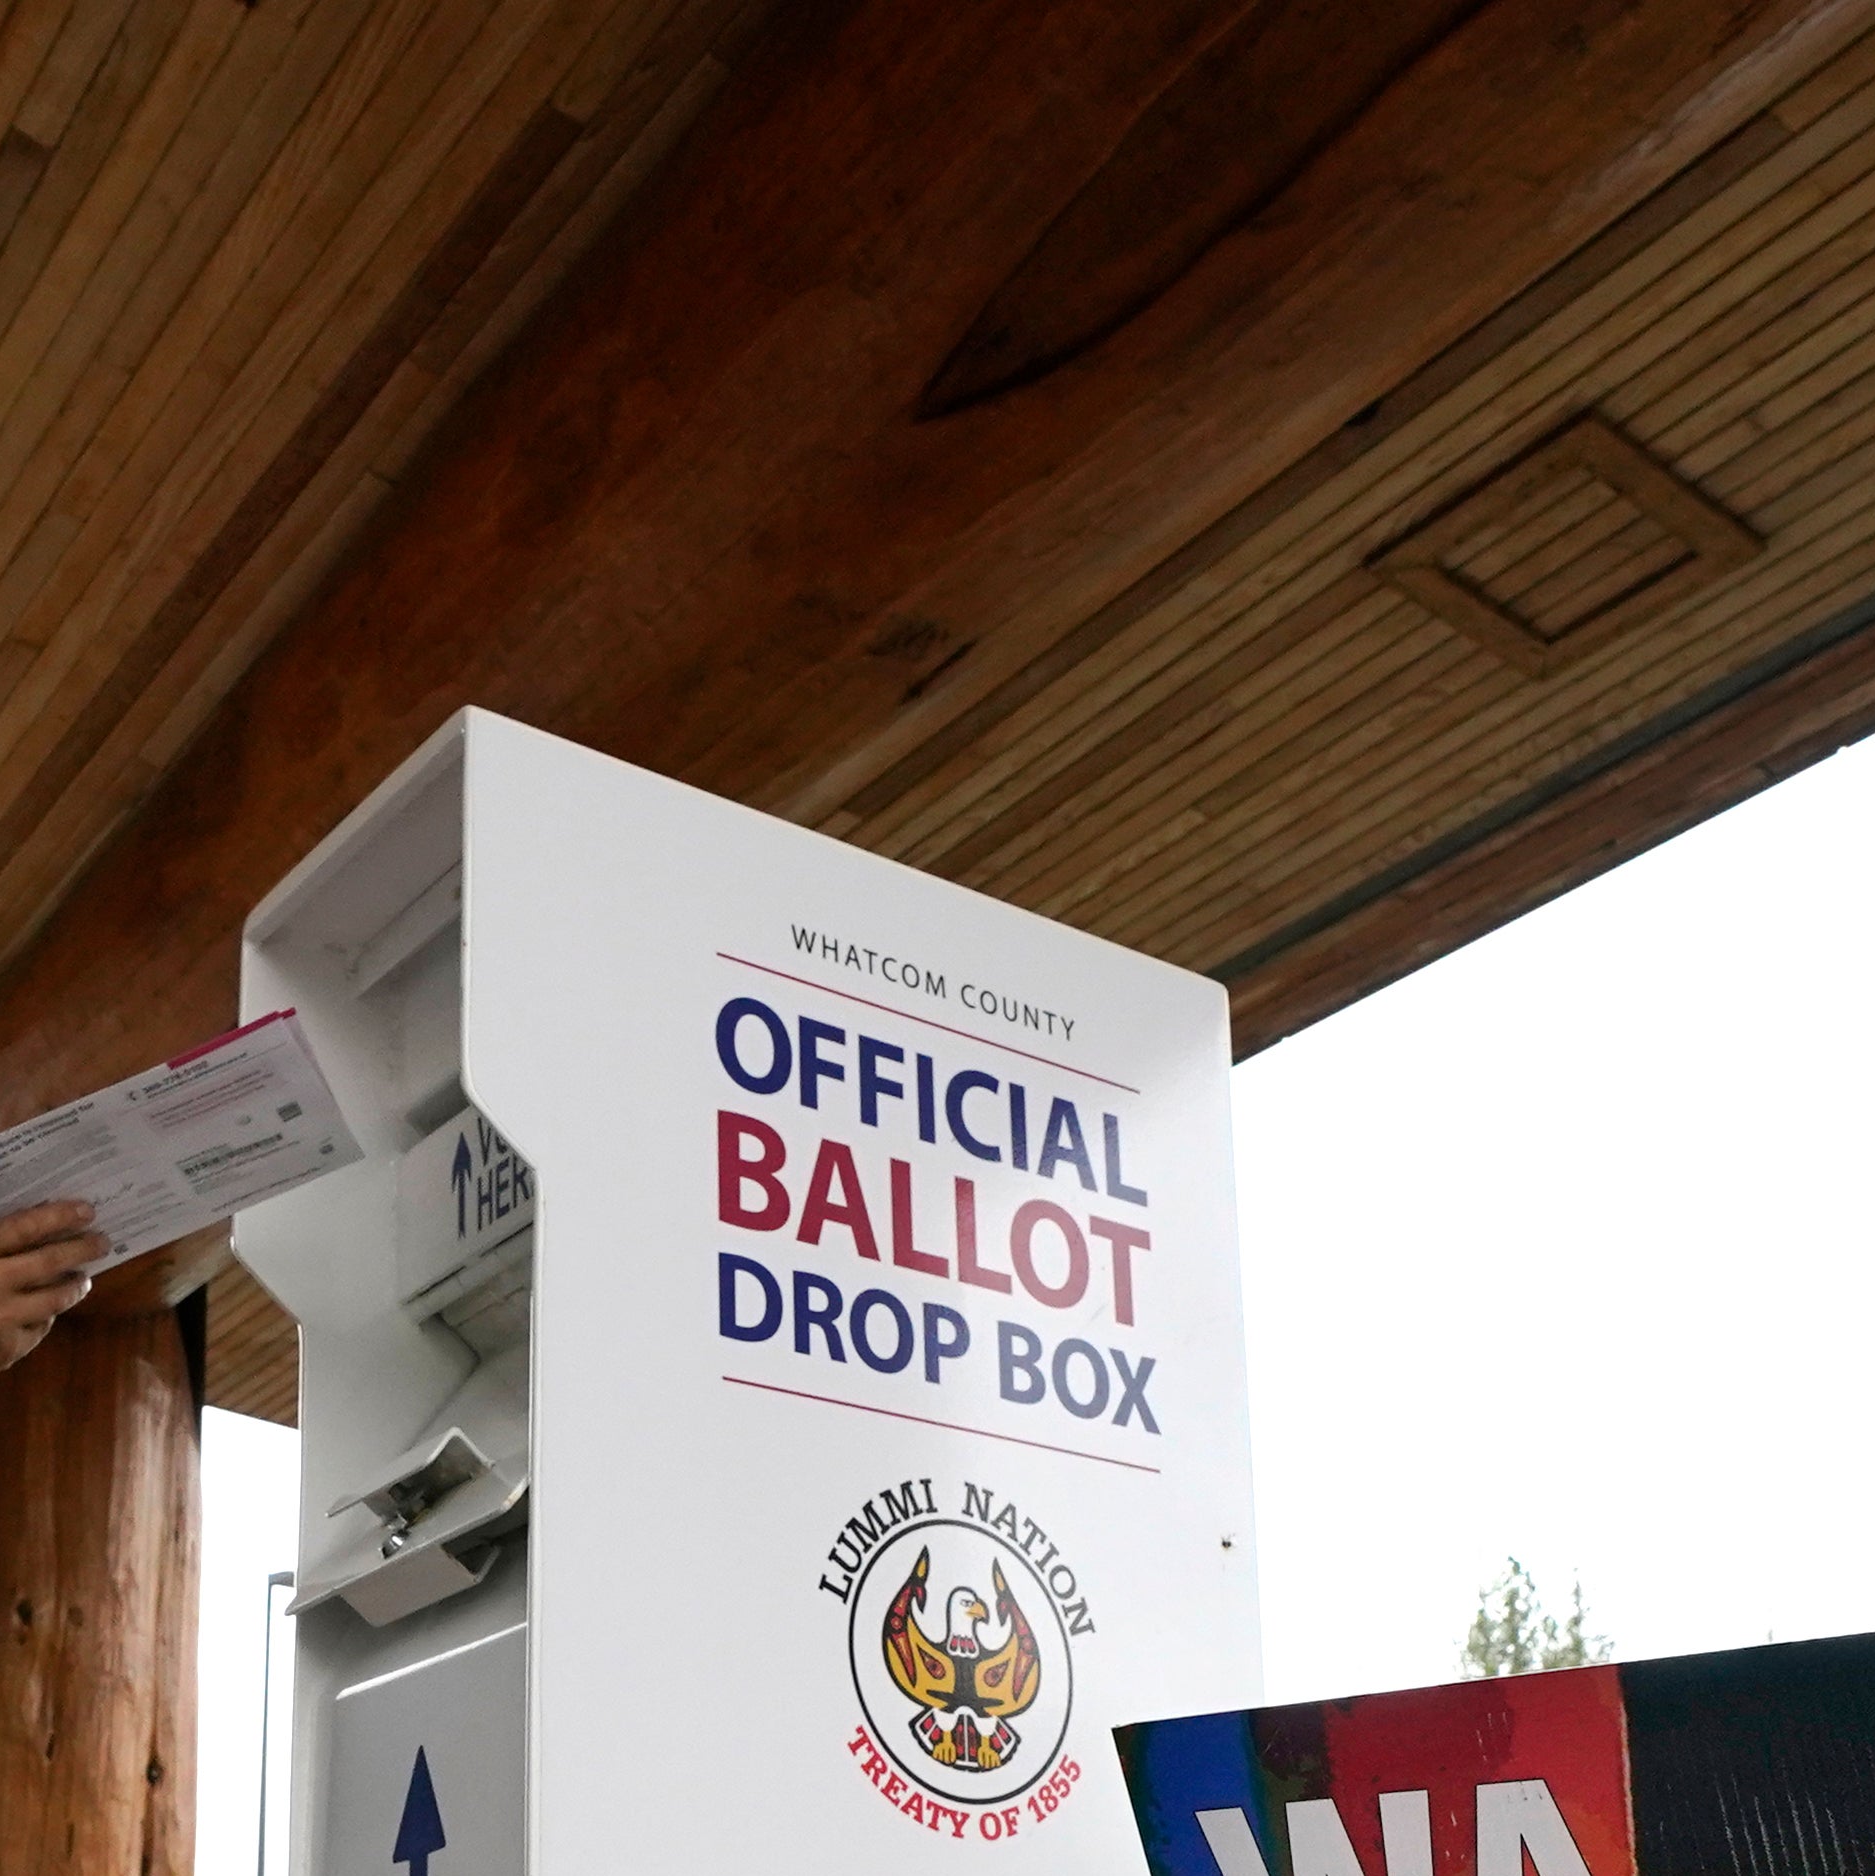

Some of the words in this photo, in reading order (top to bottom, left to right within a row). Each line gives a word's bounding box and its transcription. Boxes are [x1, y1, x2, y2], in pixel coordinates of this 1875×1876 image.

[790, 923, 947, 999] WHATCOM
[960, 983, 1076, 1042] COUNTY
[715, 997, 1148, 1208] OFFICIAL
[477, 1153, 535, 1232] HER
[717, 1109, 1152, 1328] BALLOT
[718, 1252, 971, 1385] DROP
[997, 1320, 1162, 1435] BOX
[819, 1478, 939, 1605] LUMMI
[961, 1481, 1096, 1638] NATION
[847, 1724, 971, 1840] TREATY
[978, 1806, 1022, 1842] OF
[1026, 1754, 1082, 1824] 1855
